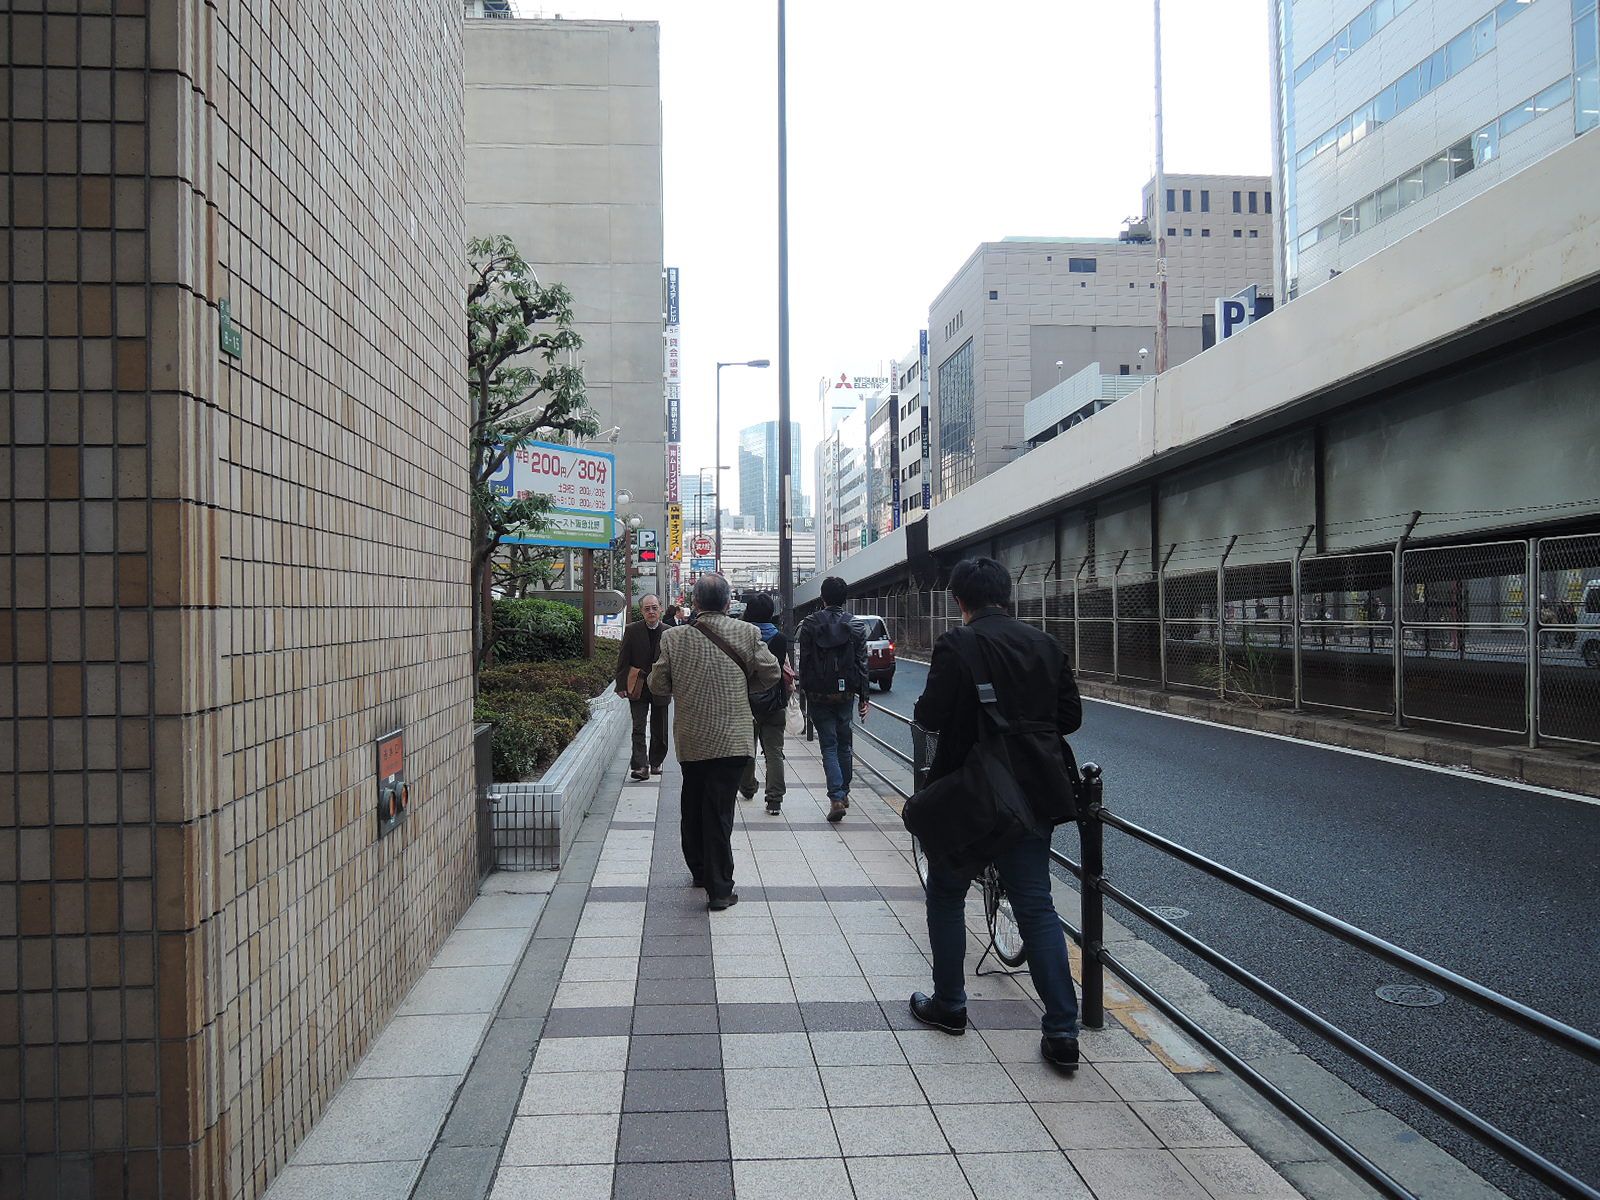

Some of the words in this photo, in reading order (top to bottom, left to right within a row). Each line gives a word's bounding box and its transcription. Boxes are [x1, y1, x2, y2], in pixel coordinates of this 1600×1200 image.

[1223, 301, 1245, 338] P
[495, 485, 509, 494] 24H
[640, 531, 654, 547] P
